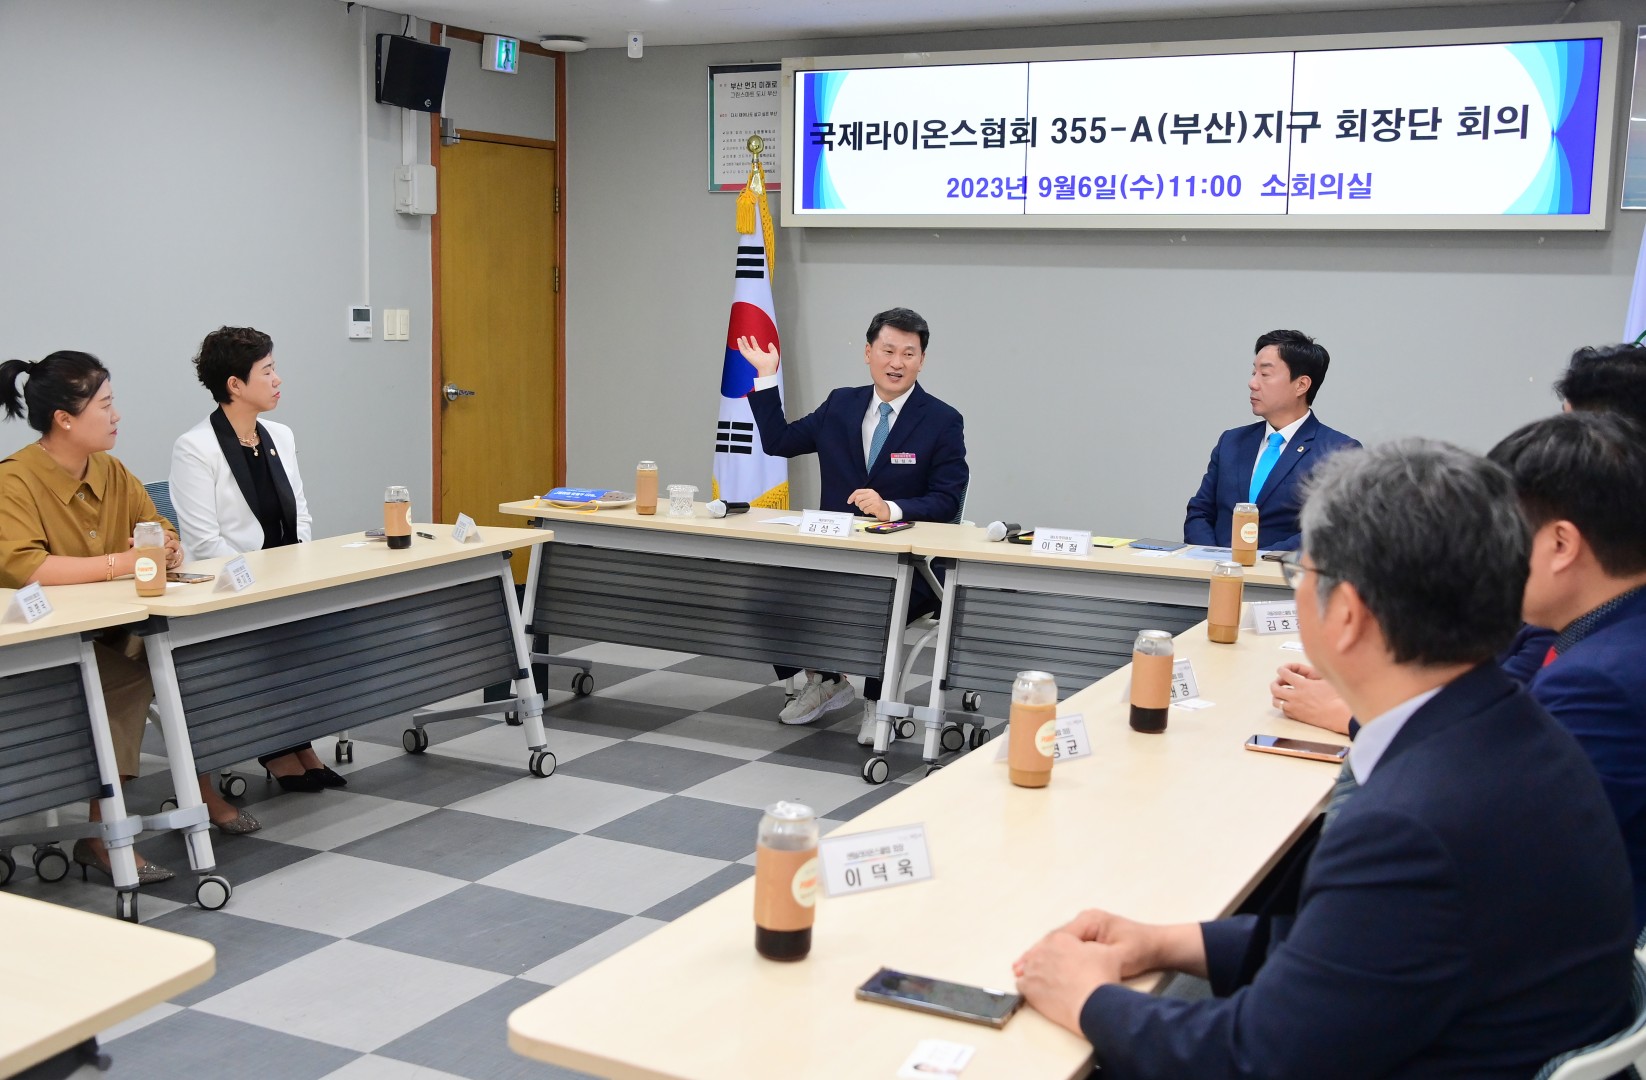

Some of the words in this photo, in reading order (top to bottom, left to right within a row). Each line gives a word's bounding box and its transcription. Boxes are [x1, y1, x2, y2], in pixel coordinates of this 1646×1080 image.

[730, 82, 743, 90] 부산
[744, 81, 757, 90] 먼저
[810, 116, 1037, 152] 국제라이온스협회
[1050, 110, 1322, 145] 355-A(부산)지구
[1335, 106, 1443, 143] 회장단
[1456, 104, 1530, 140] 회의
[946, 176, 1027, 200] 2023년
[1038, 174, 1242, 200] 9월6일(수)11:00
[1261, 172, 1373, 200] 소회의실
[844, 858, 914, 887] 이덕욱
